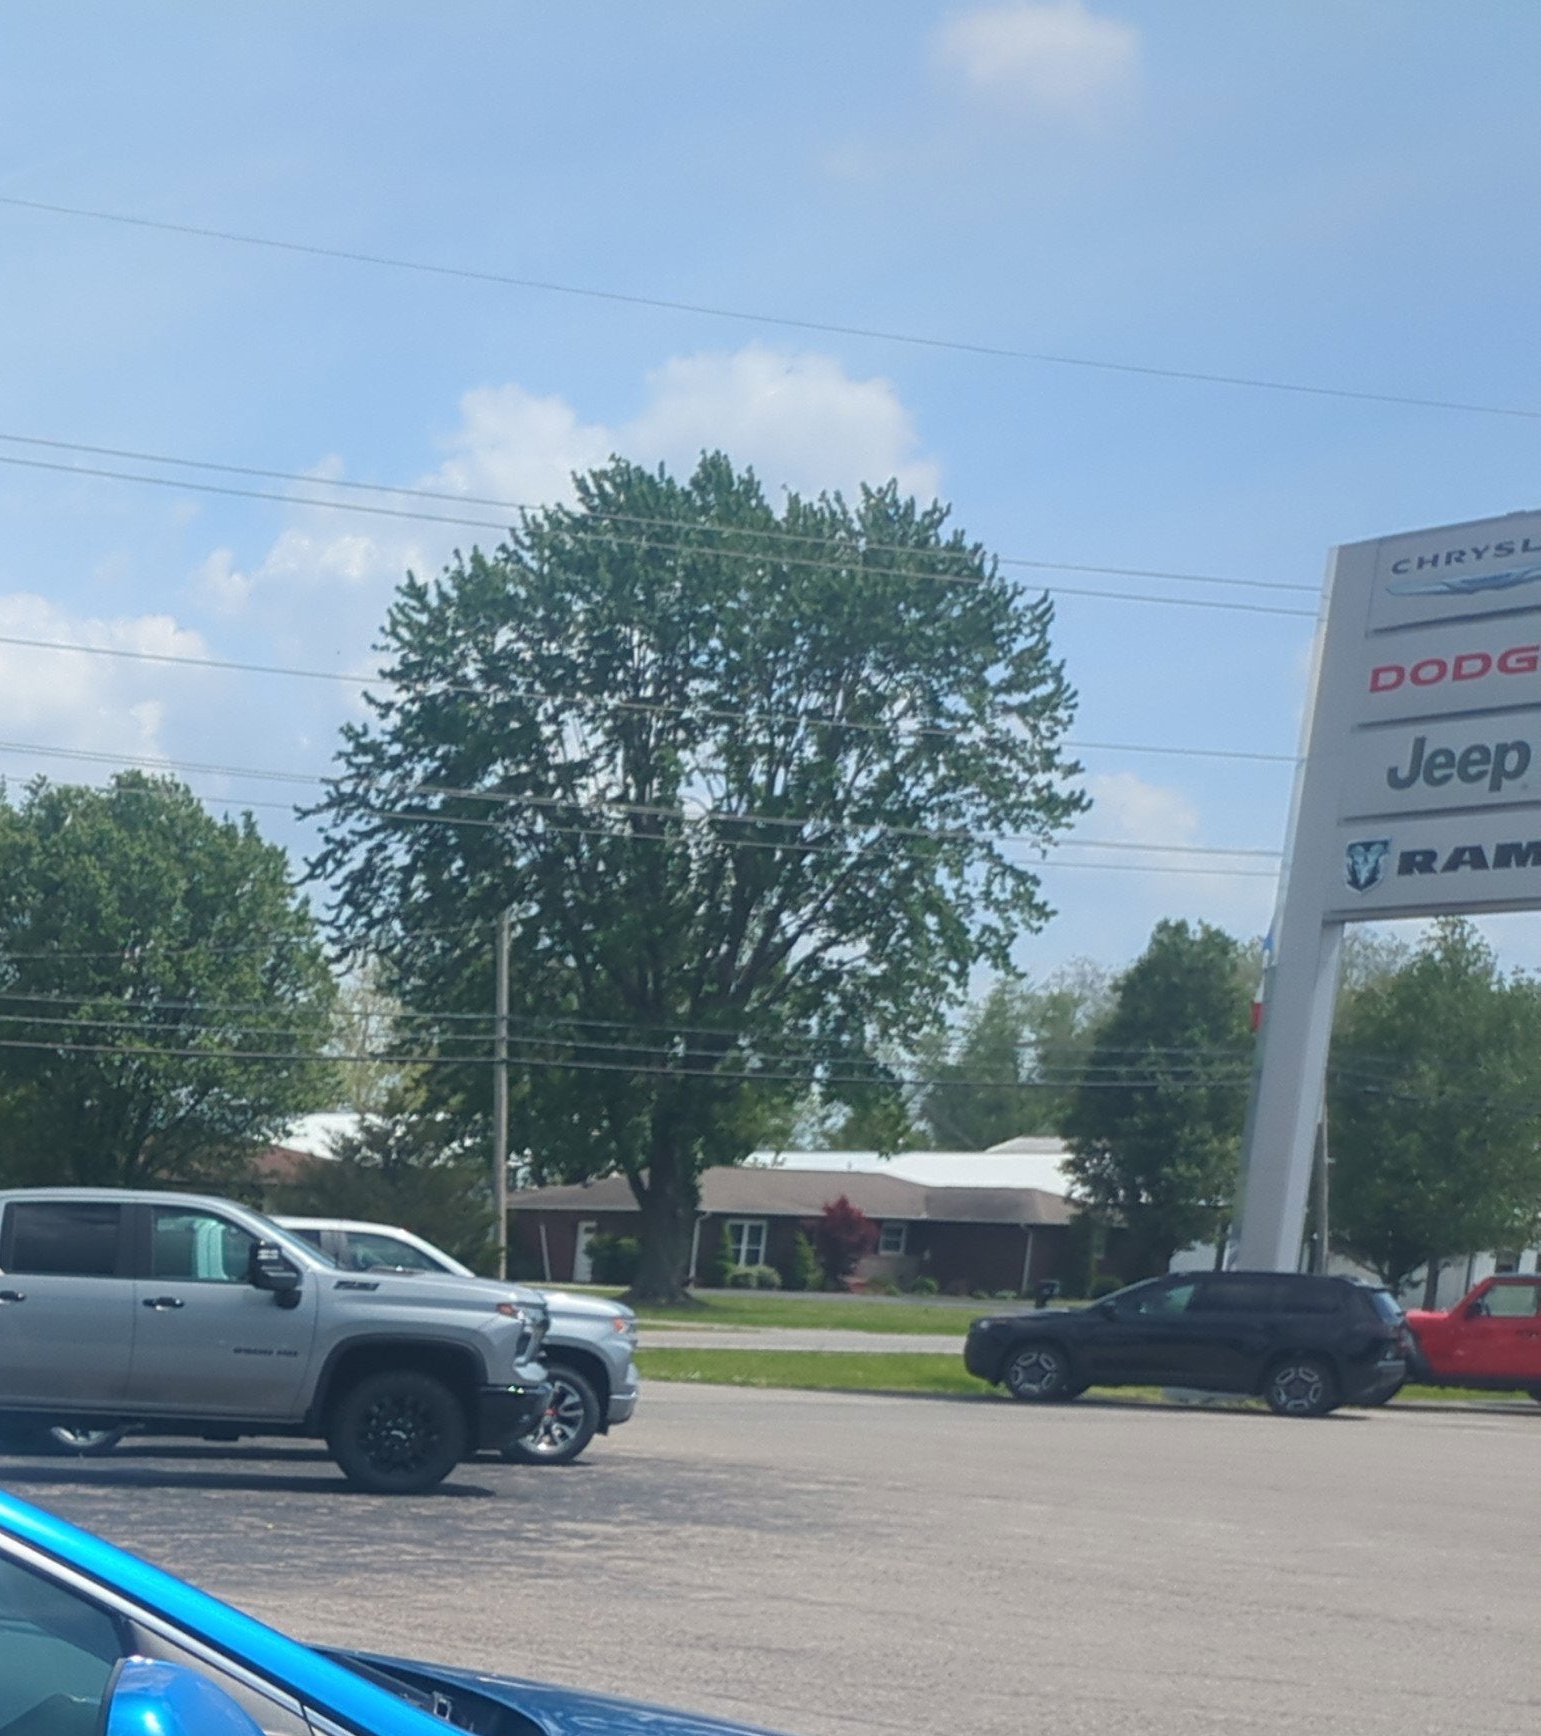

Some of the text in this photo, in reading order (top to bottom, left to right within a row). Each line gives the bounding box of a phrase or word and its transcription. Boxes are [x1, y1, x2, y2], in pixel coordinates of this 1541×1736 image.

[1370, 645, 1541, 693] DODG
[1386, 735, 1531, 792] Jeep
[1397, 841, 1541, 877] RAM
